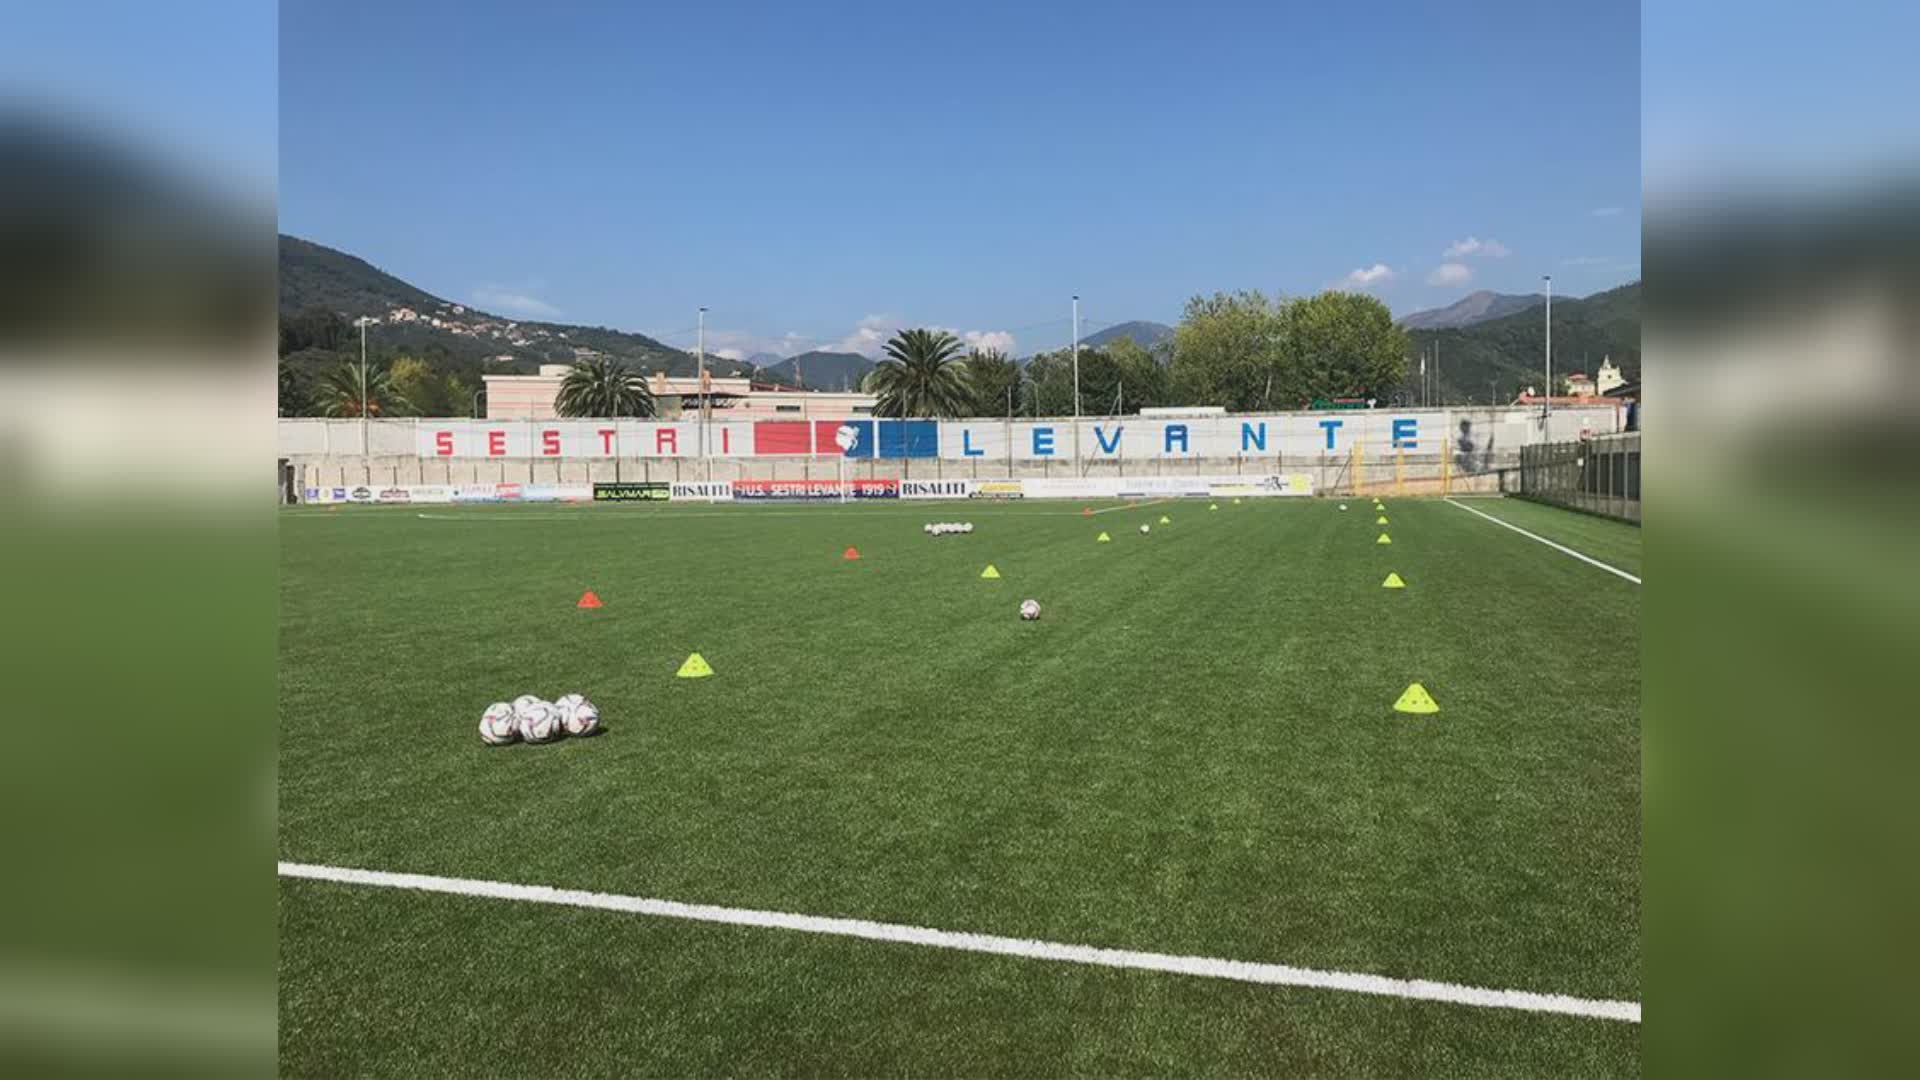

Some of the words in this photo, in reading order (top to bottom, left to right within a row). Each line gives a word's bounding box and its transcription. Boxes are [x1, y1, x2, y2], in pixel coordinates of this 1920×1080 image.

[436, 428, 729, 456] SESTRI
[963, 419, 1419, 456] LEVANTE
[770, 484, 808, 496] SESTRI
[861, 483, 884, 496] 1919
